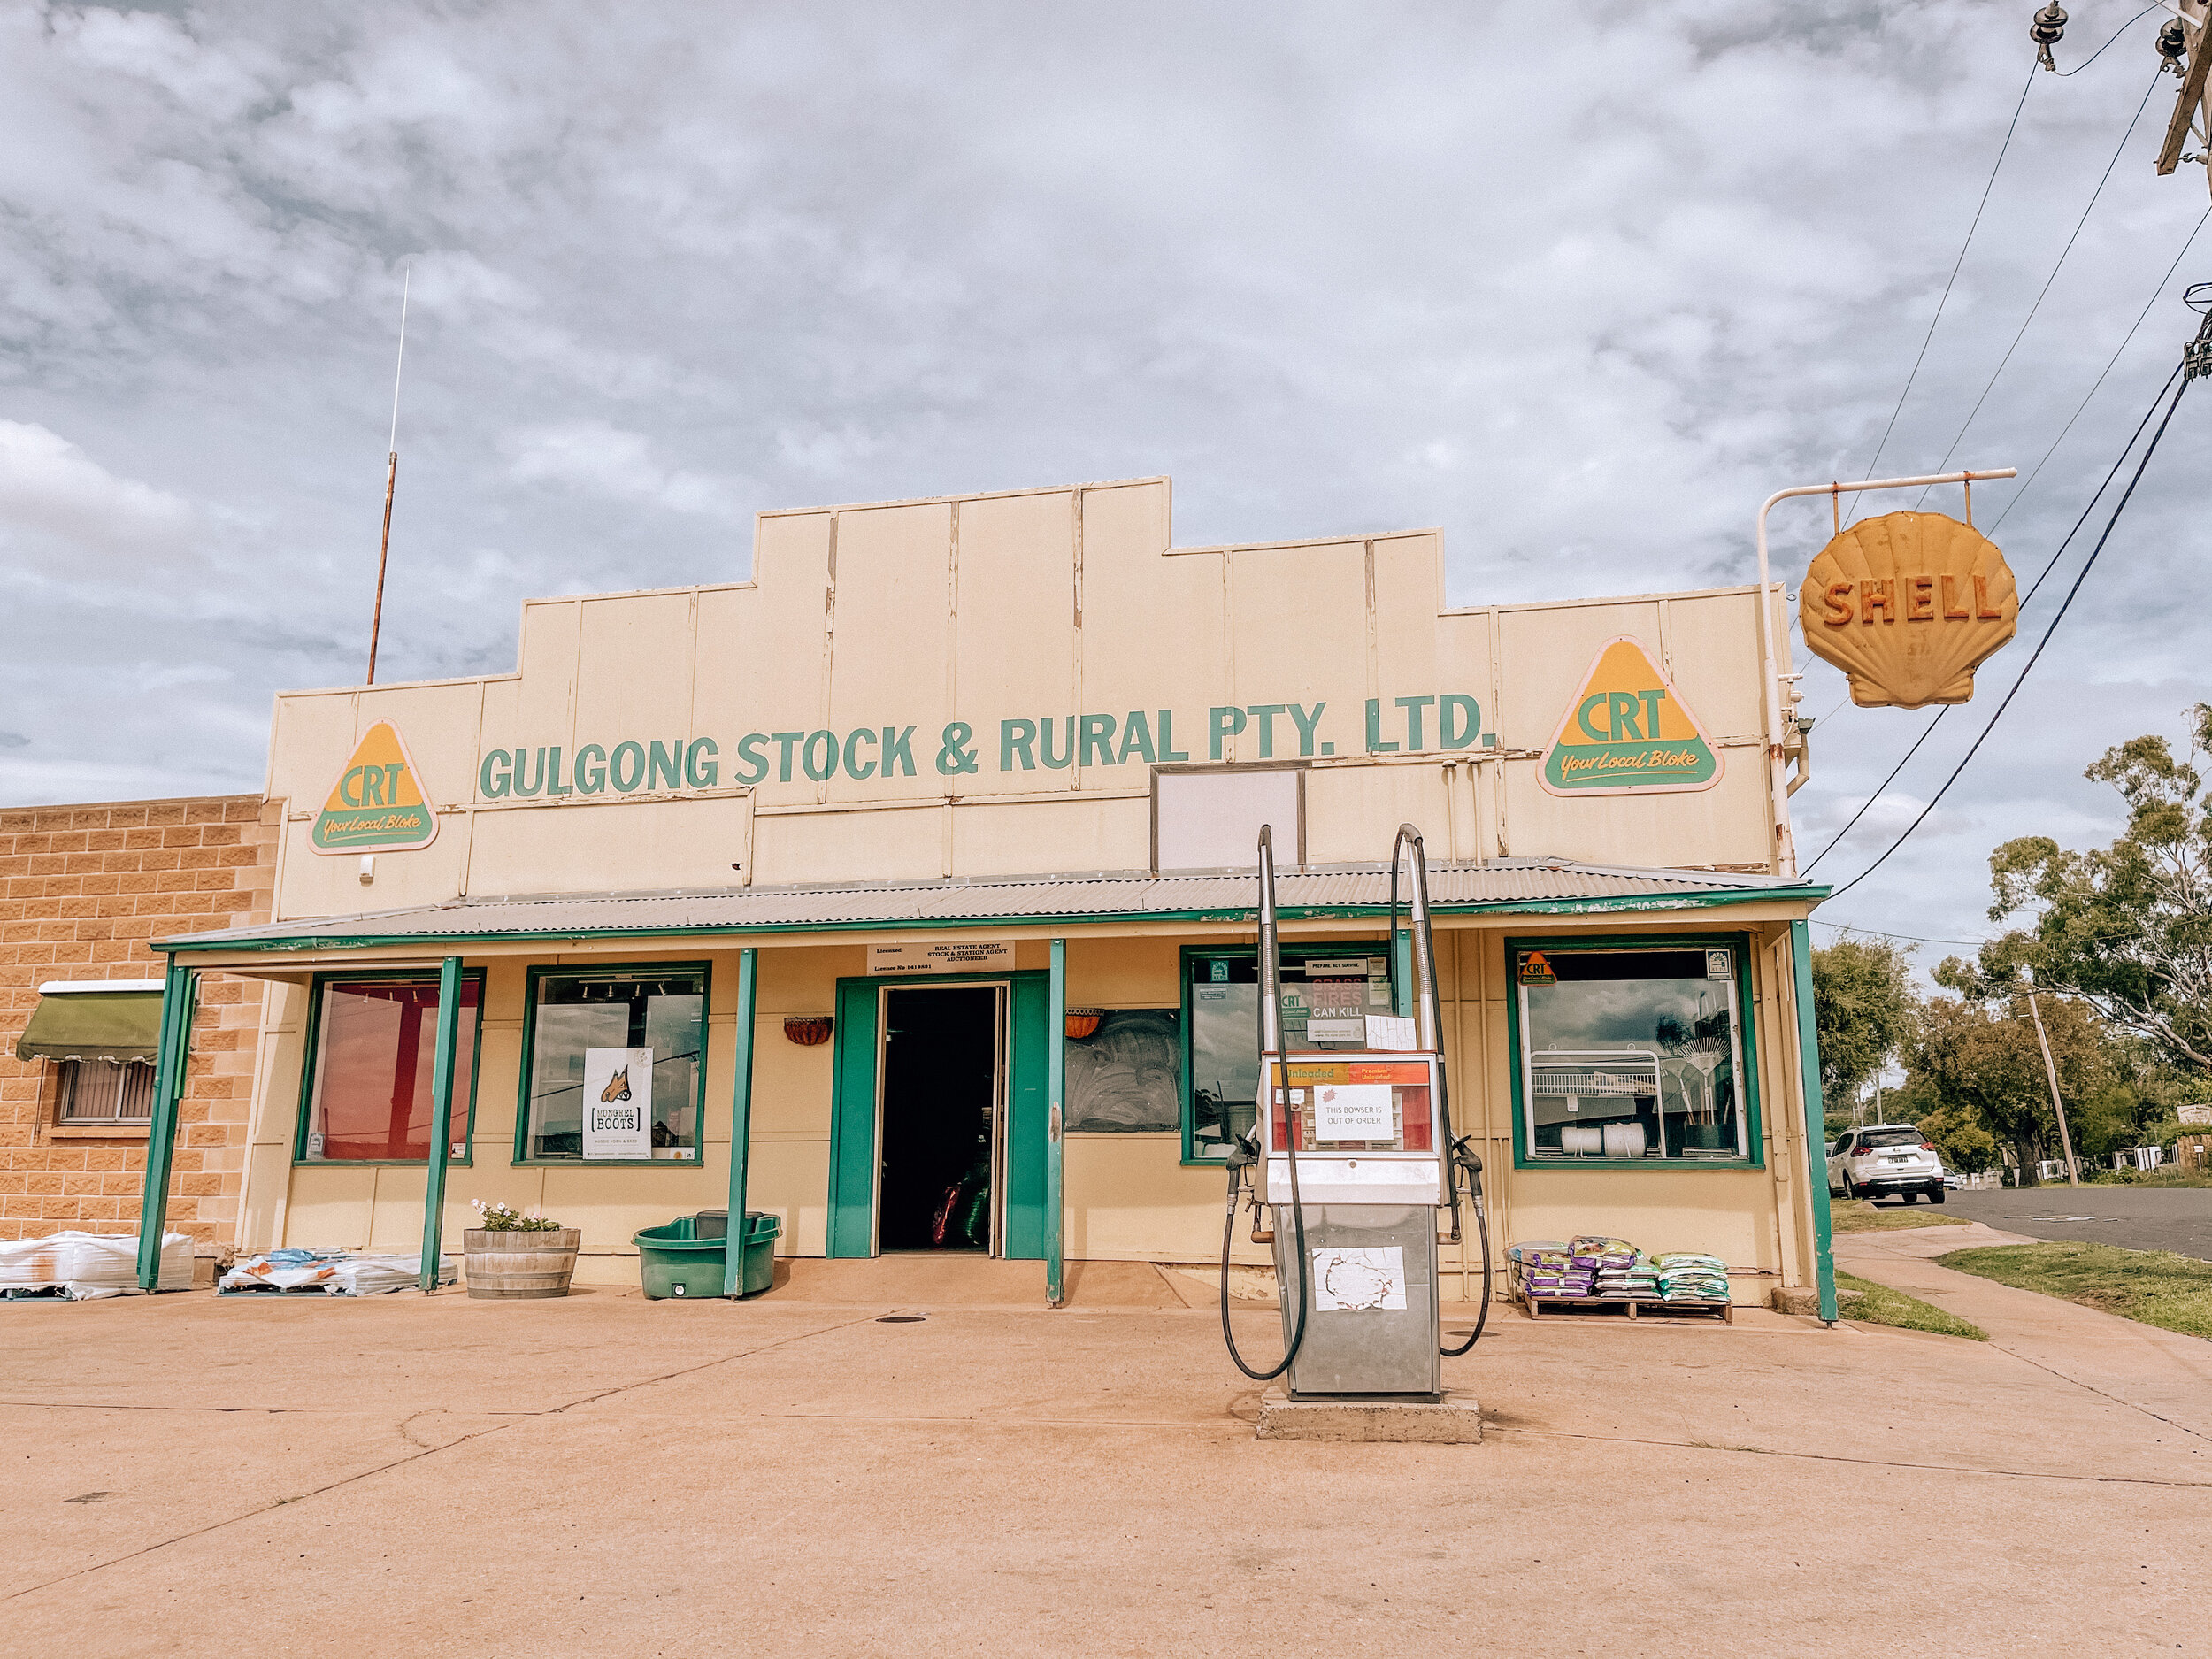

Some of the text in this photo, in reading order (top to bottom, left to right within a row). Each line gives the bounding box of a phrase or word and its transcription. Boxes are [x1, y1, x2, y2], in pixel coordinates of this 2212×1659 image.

[1824, 575, 2001, 626] SHELL
[1578, 689, 1665, 741] CRT
[480, 694, 1496, 798] GULGONG STOCK & RURAL PTY. LTD.
[1560, 749, 1699, 780] Your Local Bloke
[340, 763, 404, 807] CRT
[324, 813, 421, 841] Your Local Bloke
[1527, 963, 1545, 974] CRT
[1312, 978, 1362, 991] GRASS
[1281, 995, 1301, 1007] CRT
[1313, 992, 1363, 1006] FIRES
[1313, 1007, 1363, 1018] CAN KILL
[596, 1118, 634, 1129] BOOTS
